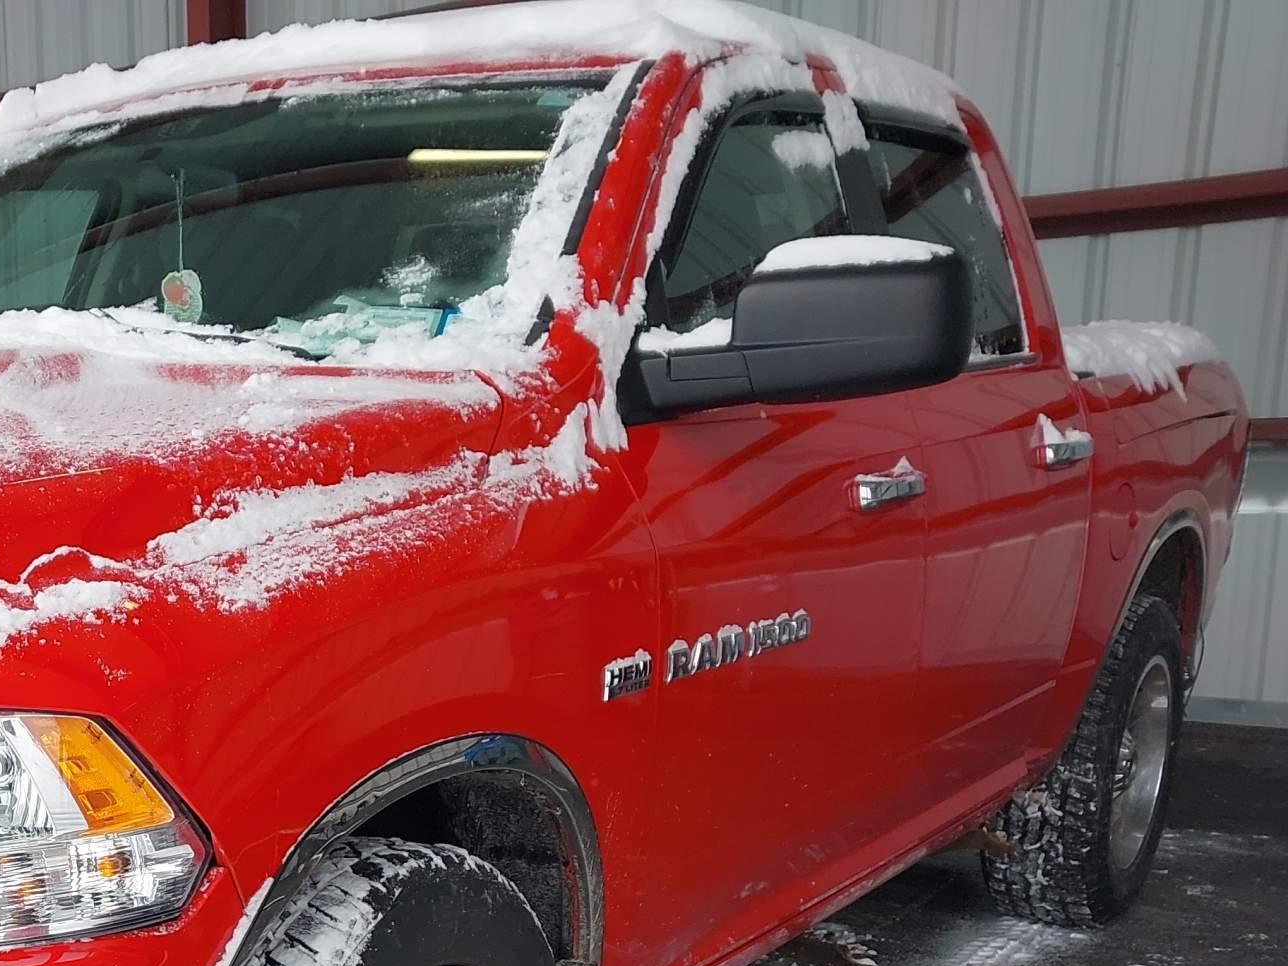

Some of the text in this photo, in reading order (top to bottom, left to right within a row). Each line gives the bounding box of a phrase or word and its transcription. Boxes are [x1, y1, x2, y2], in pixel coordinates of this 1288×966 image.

[606, 656, 652, 688] HEMI
[666, 611, 810, 684] RAM 1500
